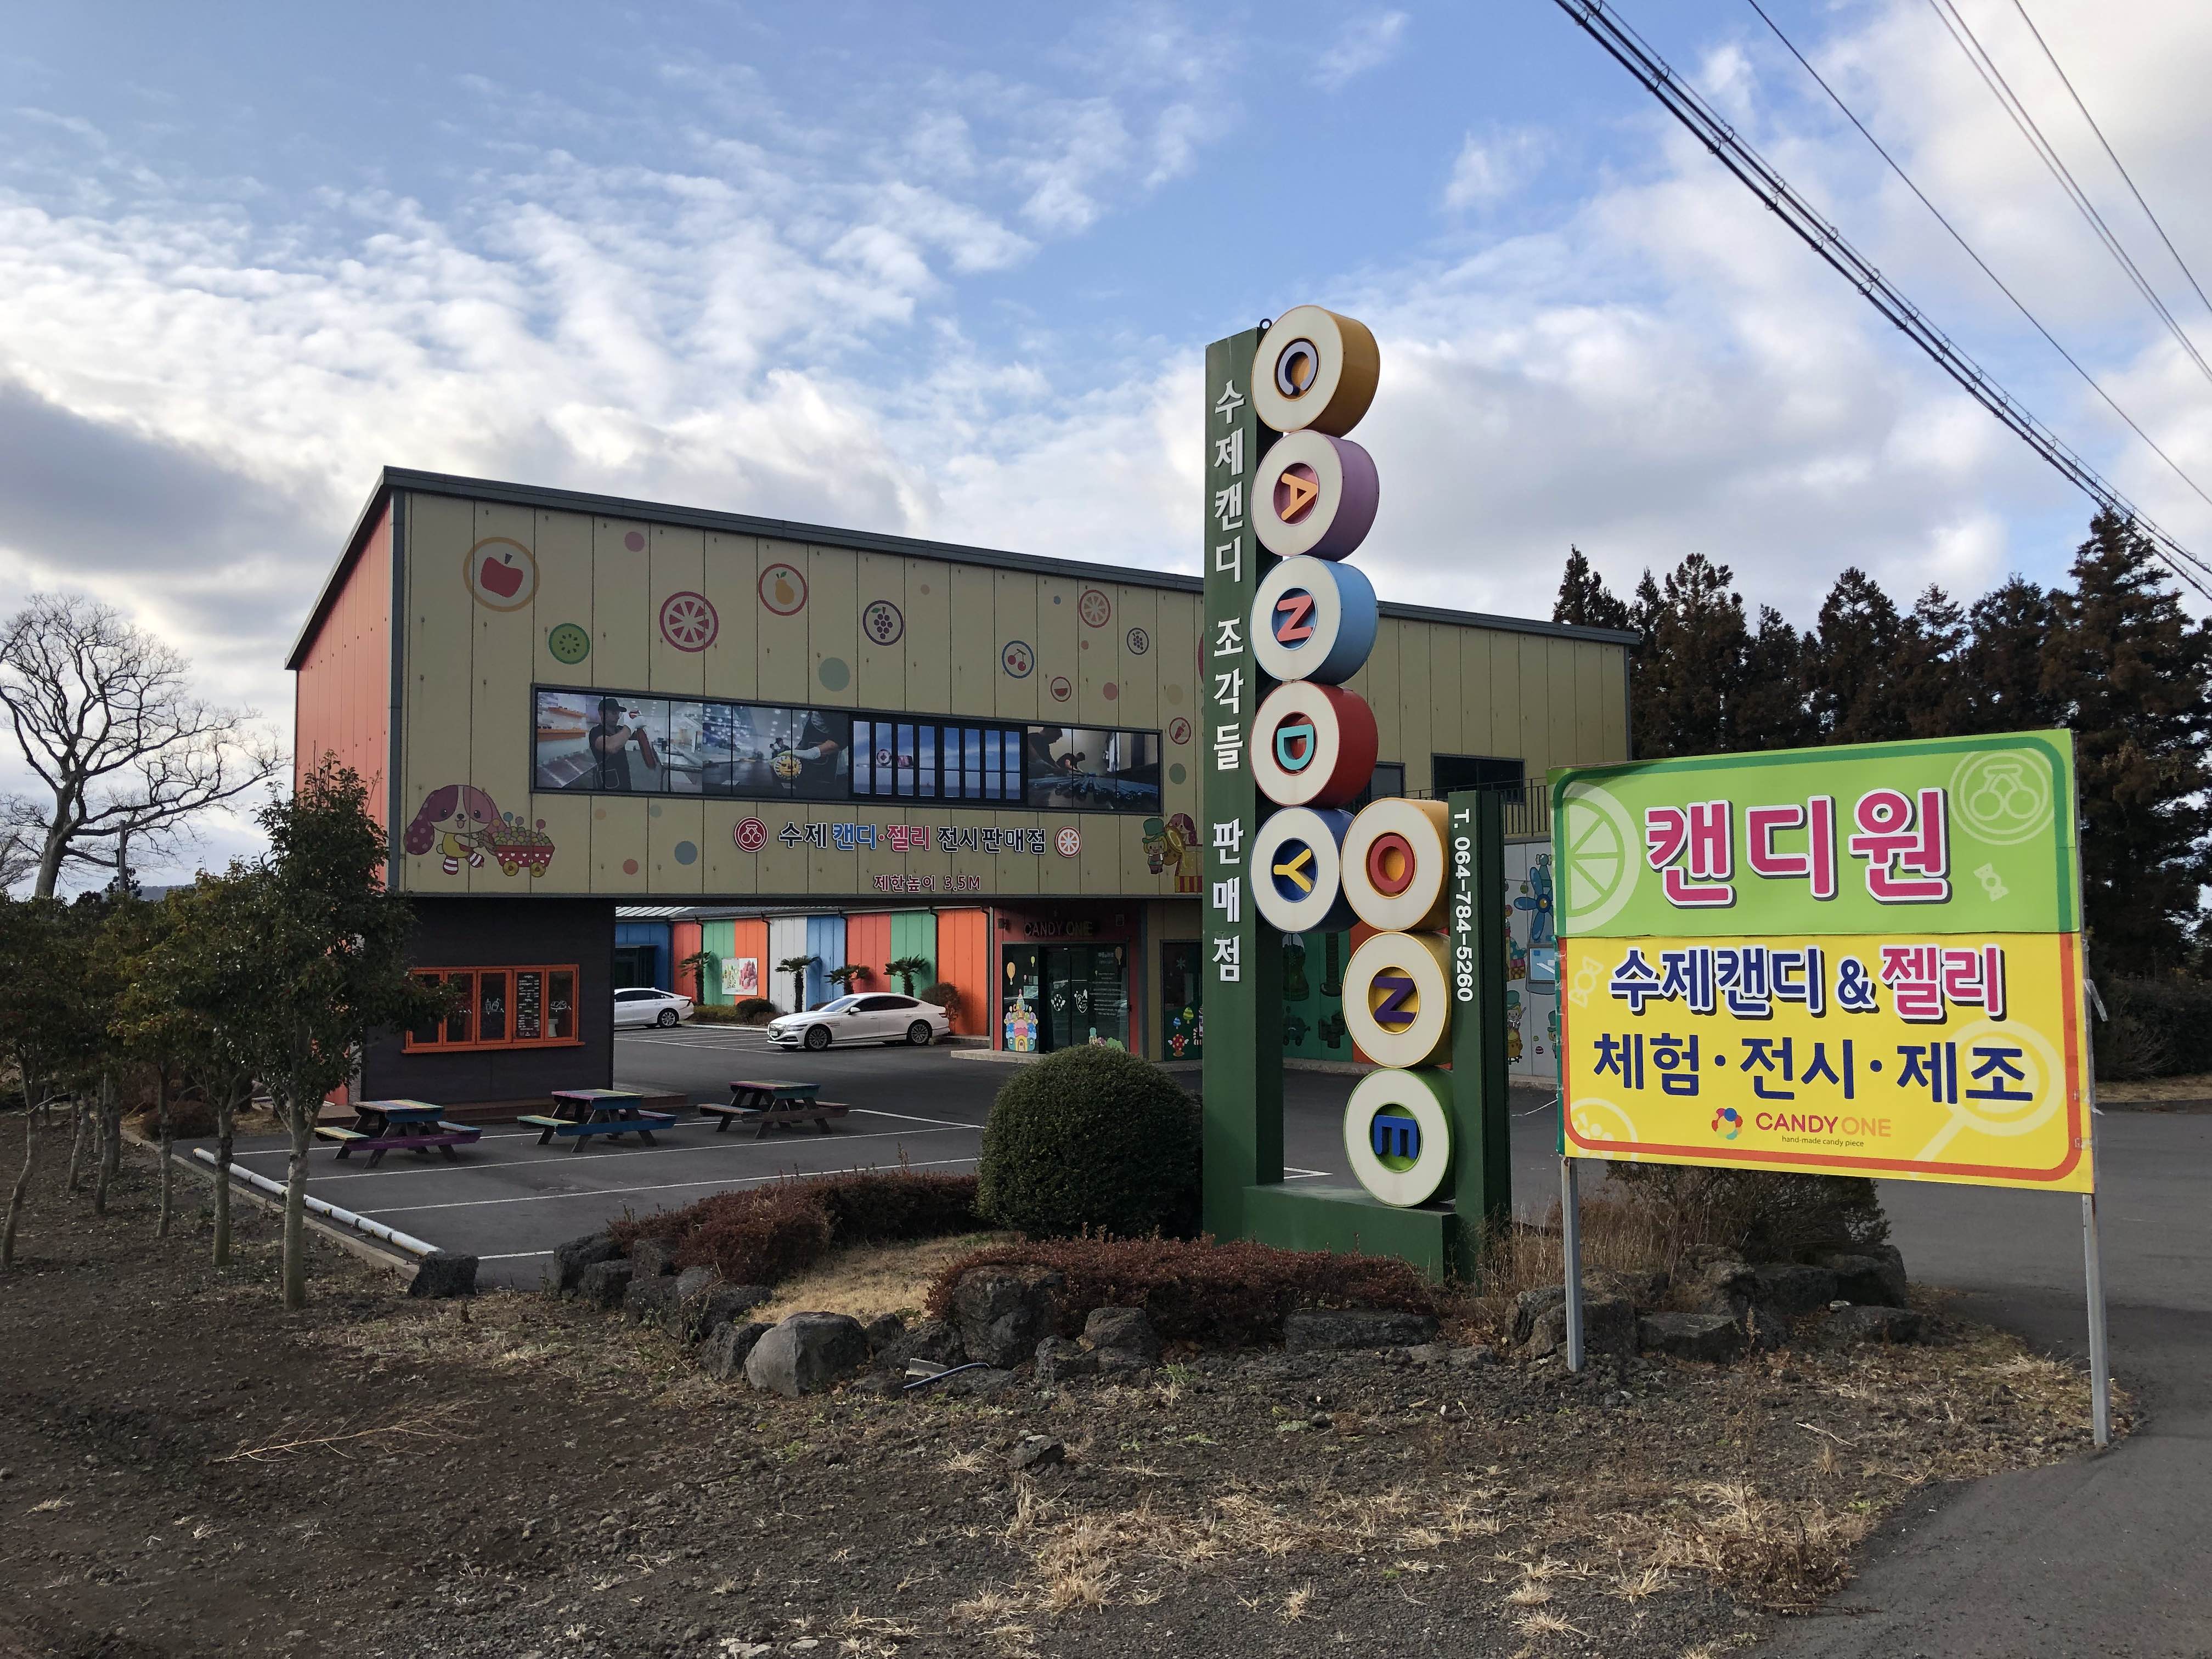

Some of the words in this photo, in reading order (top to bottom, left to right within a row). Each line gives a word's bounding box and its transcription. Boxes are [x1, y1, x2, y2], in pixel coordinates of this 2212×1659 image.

[1214, 379, 1245, 583] 수제캔디
[1212, 617, 1244, 771] 조각들
[779, 821, 828, 849] 수제
[874, 874, 936, 893] 제한높이
[944, 875, 981, 891] 3.5M
[1646, 787, 1953, 909] 캔디원
[1024, 921, 1062, 936] CANDY
[1066, 921, 1093, 936] ONE
[1212, 817, 1244, 983] 판매점
[1454, 836, 1474, 1002] 064-784-5260
[1781, 1135, 1821, 1145] hand-made
[1822, 1138, 1844, 1147] candy
[1844, 1139, 1865, 1147] piece
